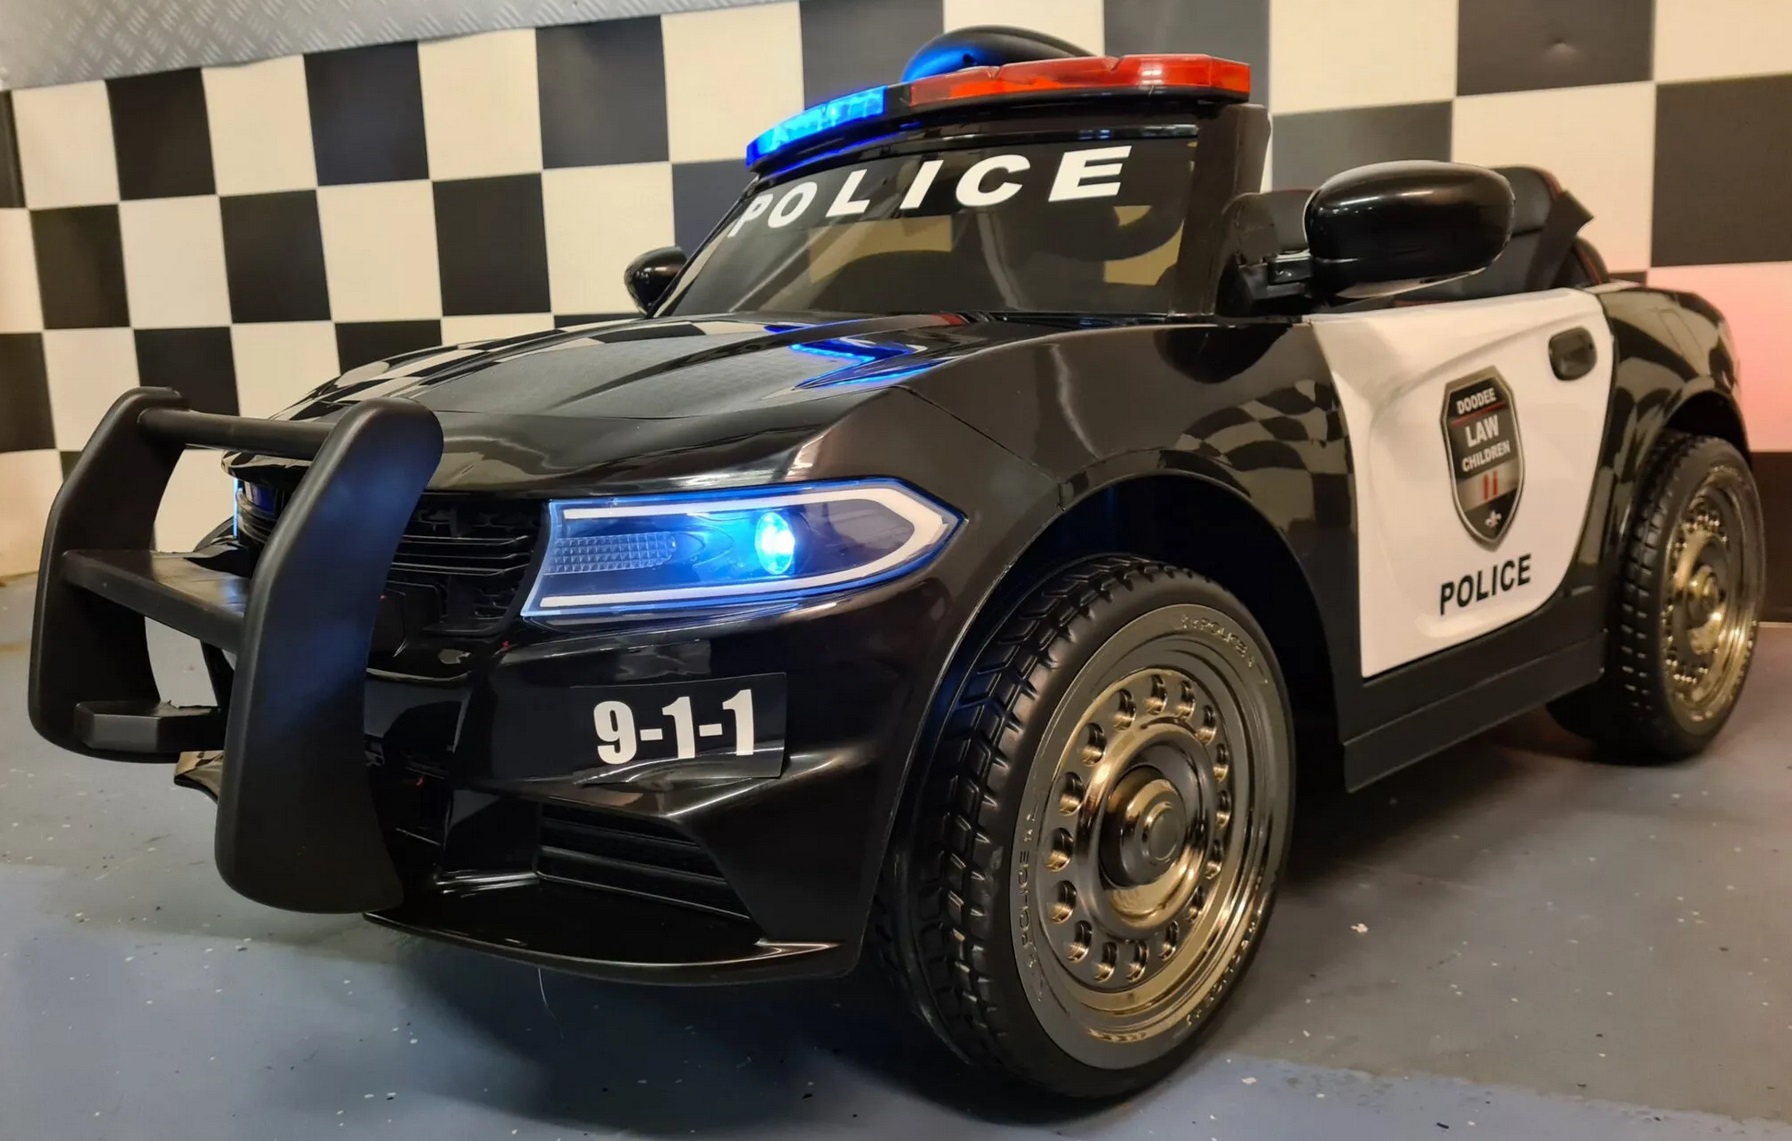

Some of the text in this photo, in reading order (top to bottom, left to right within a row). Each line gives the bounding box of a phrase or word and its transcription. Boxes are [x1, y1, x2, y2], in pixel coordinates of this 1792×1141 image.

[727, 145, 1132, 238] POLICE
[1456, 387, 1497, 415] DOODEE
[1465, 415, 1499, 448] LAW
[1462, 440, 1511, 472] CHILDREN
[1440, 553, 1531, 616] POLICE
[593, 689, 755, 764] 9-1-1
